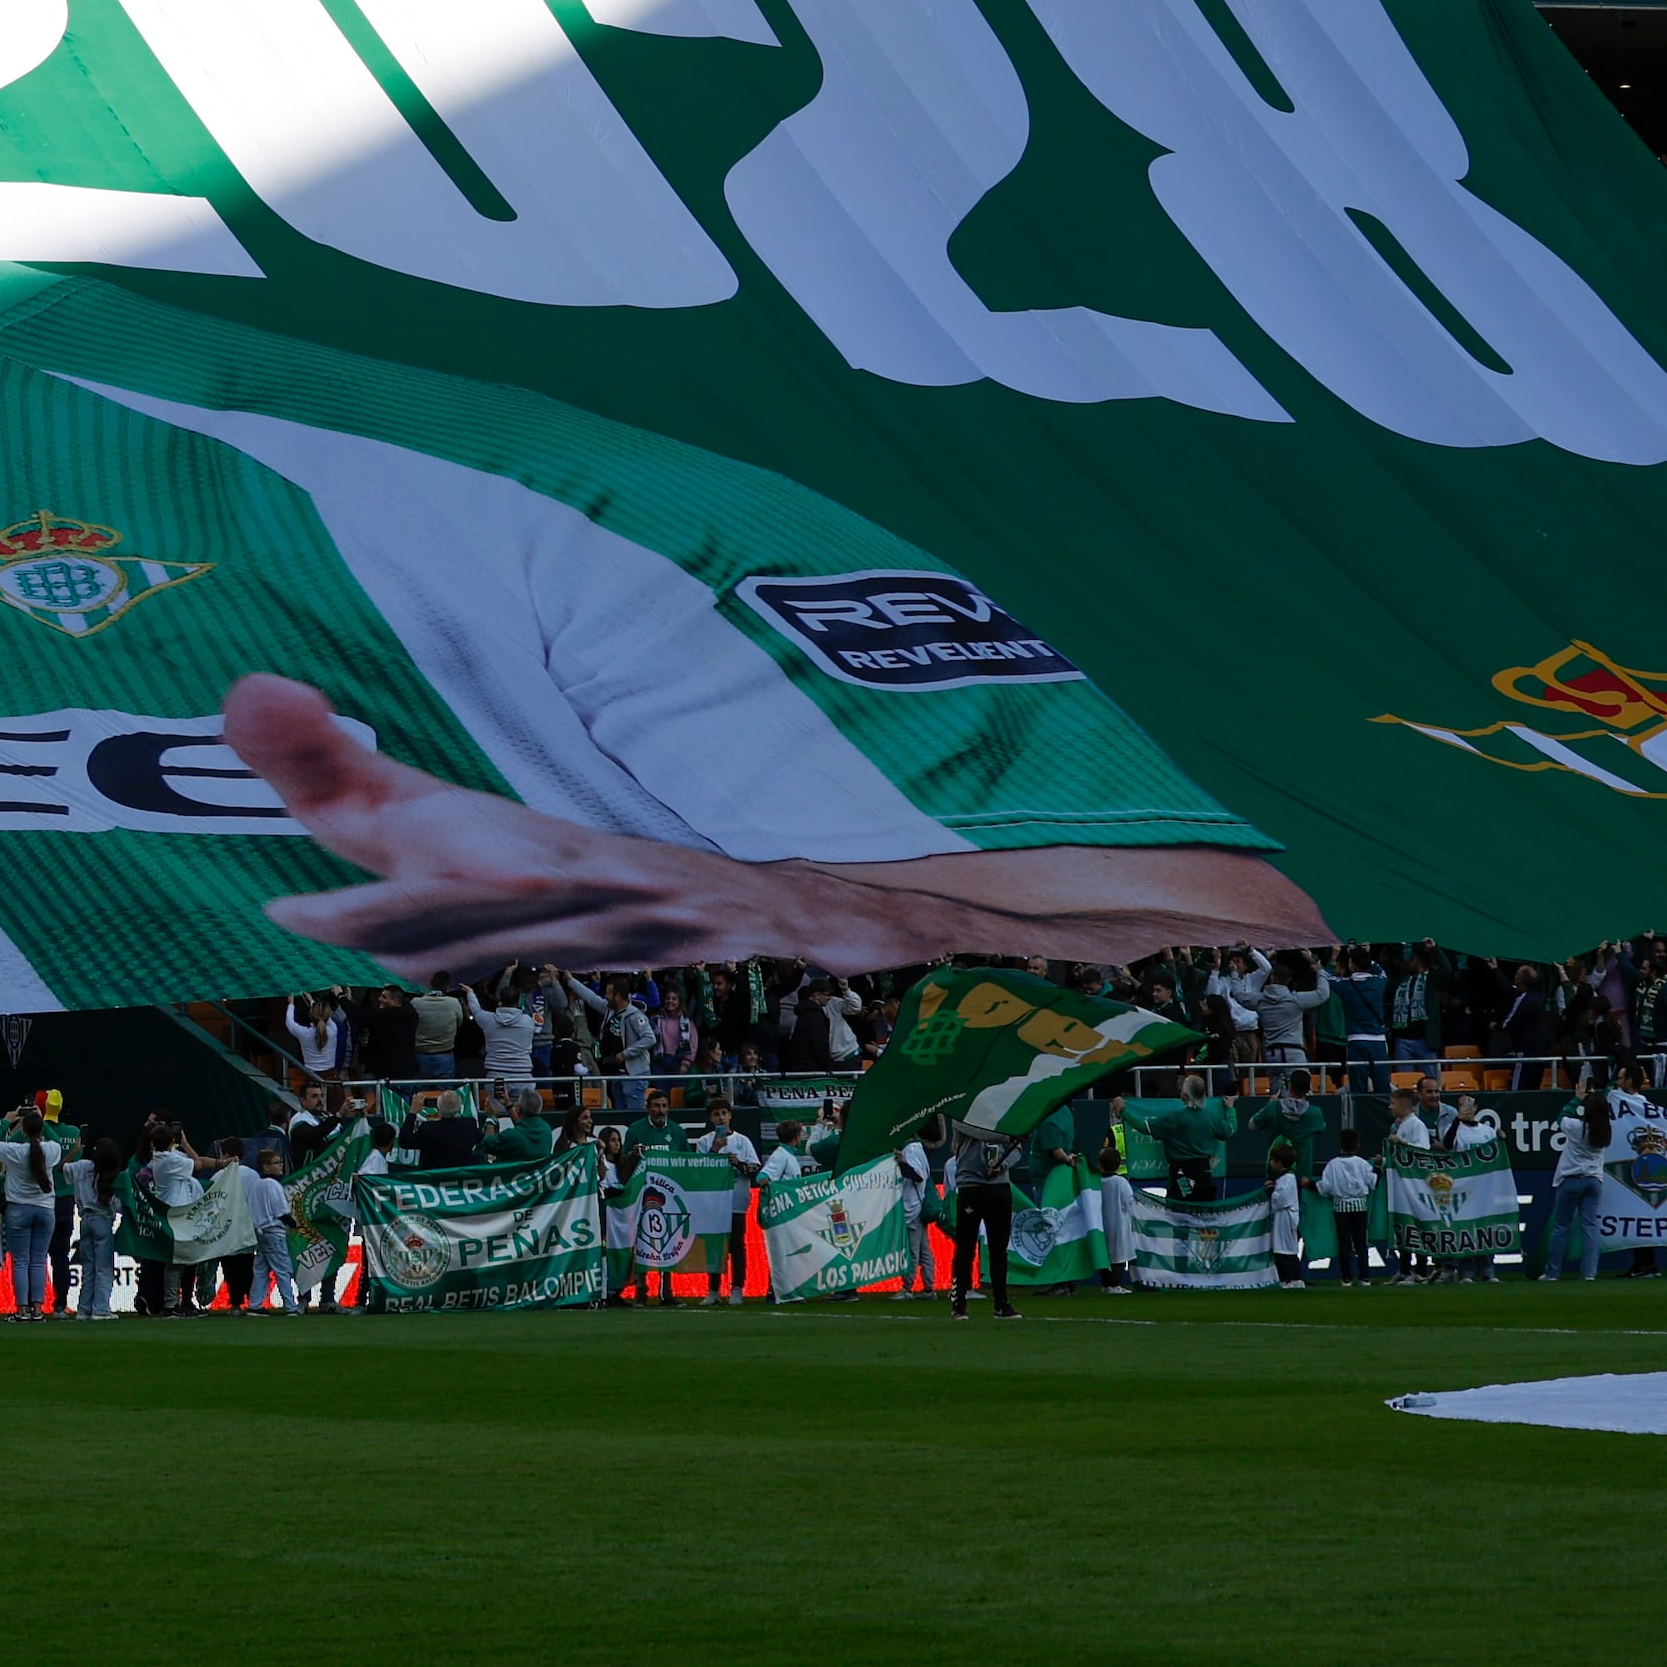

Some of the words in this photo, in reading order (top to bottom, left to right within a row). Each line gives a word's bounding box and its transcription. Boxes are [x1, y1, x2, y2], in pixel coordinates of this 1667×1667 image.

[669, 1157, 686, 1168] wir
[372, 1156, 588, 1212] FEDERACIÓN
[795, 1181, 839, 1205] BÉTICA
[513, 1208, 534, 1224] DE
[649, 1214, 663, 1233] 13
[458, 1216, 596, 1267] PEÑAS
[1393, 1223, 1513, 1254] SERRANO
[440, 1286, 501, 1310] BETIS
[503, 1263, 604, 1306] BALOMPIÉ
[817, 1264, 848, 1292] LOS
